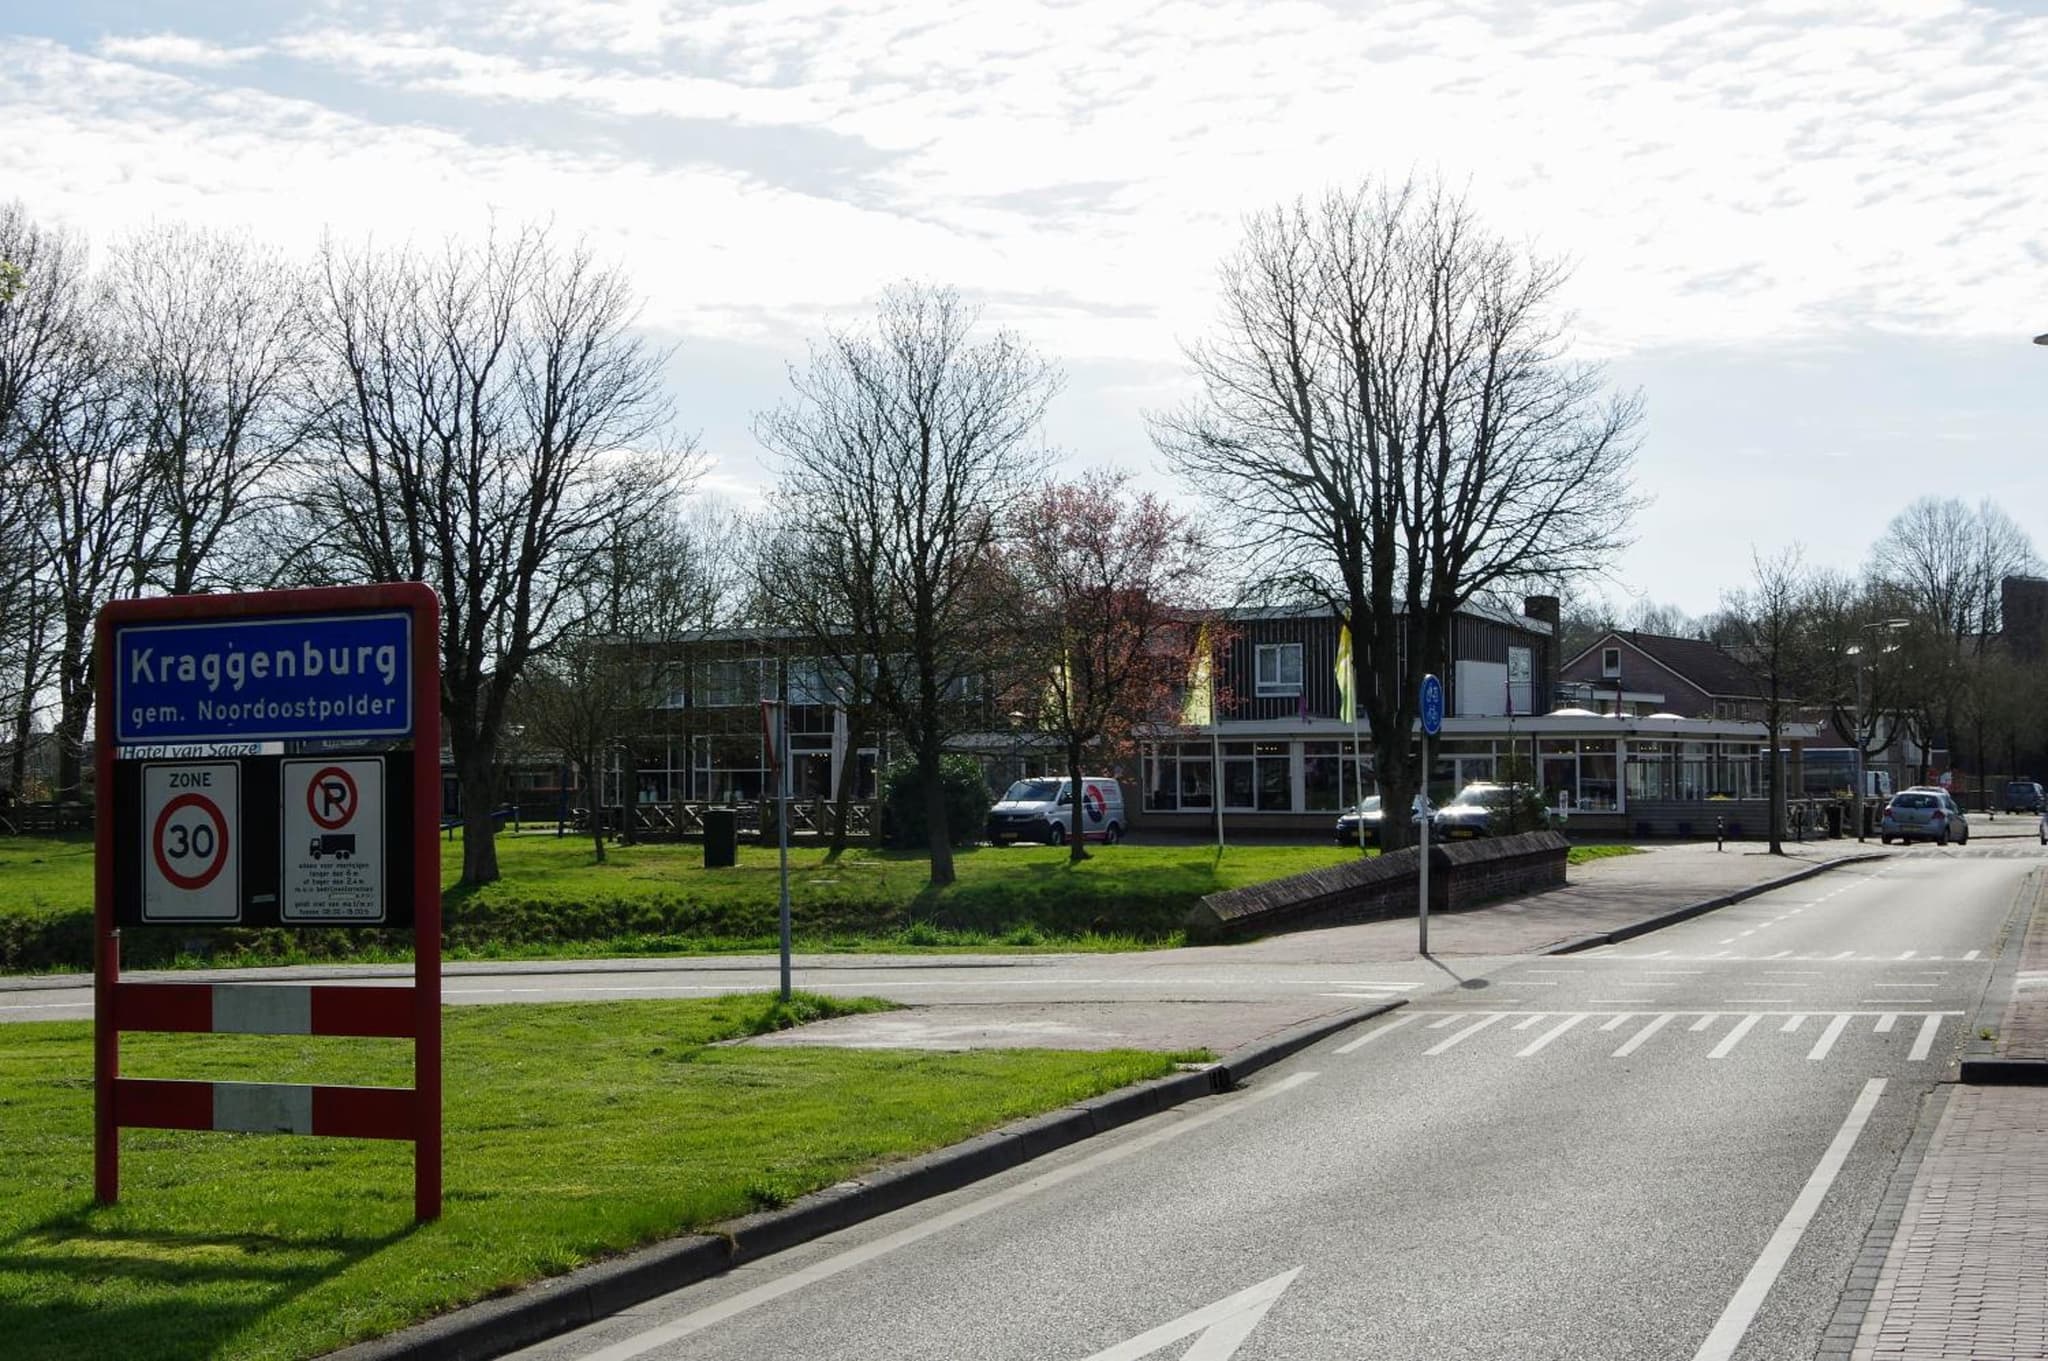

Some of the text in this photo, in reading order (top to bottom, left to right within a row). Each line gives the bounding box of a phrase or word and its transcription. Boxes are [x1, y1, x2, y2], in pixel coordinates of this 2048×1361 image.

[131, 640, 397, 692] Kraggenburg
[131, 693, 396, 729] gem. Noordoostpolder
[122, 745, 166, 760] Hotel
[171, 745, 203, 758] van
[169, 772, 212, 788] ZONE
[168, 824, 214, 859] 30
